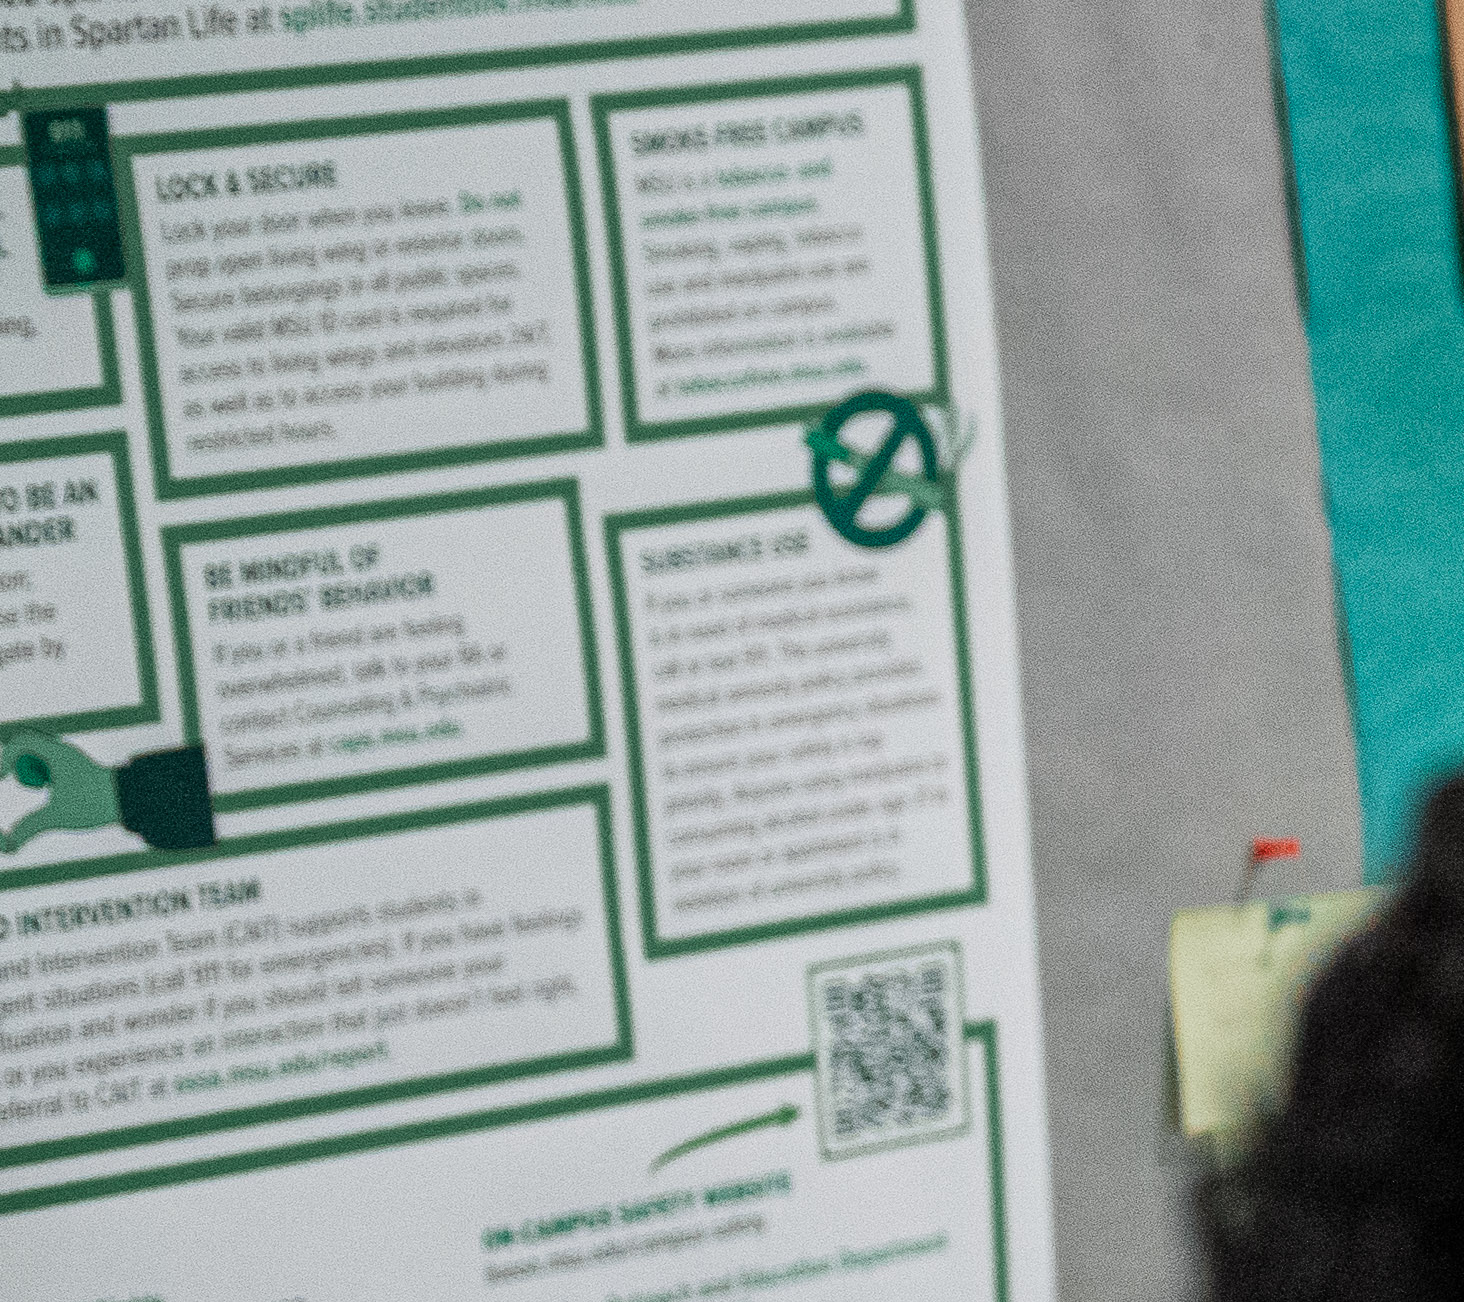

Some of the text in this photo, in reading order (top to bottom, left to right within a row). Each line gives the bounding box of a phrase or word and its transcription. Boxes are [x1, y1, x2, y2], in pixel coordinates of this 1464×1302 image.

[36, 5, 274, 51] in Spartan Life at
[156, 162, 336, 203] LOCK & SECURE
[160, 219, 208, 245] Lock
[209, 217, 254, 243] your
[25, 480, 99, 510] BE AN
[204, 545, 380, 590] BE MINDFUL OF
[319, 572, 435, 610] BEHAVIOR
[17, 879, 261, 936] INTERVENTION TEAM
[34, 940, 161, 976] Intervention
